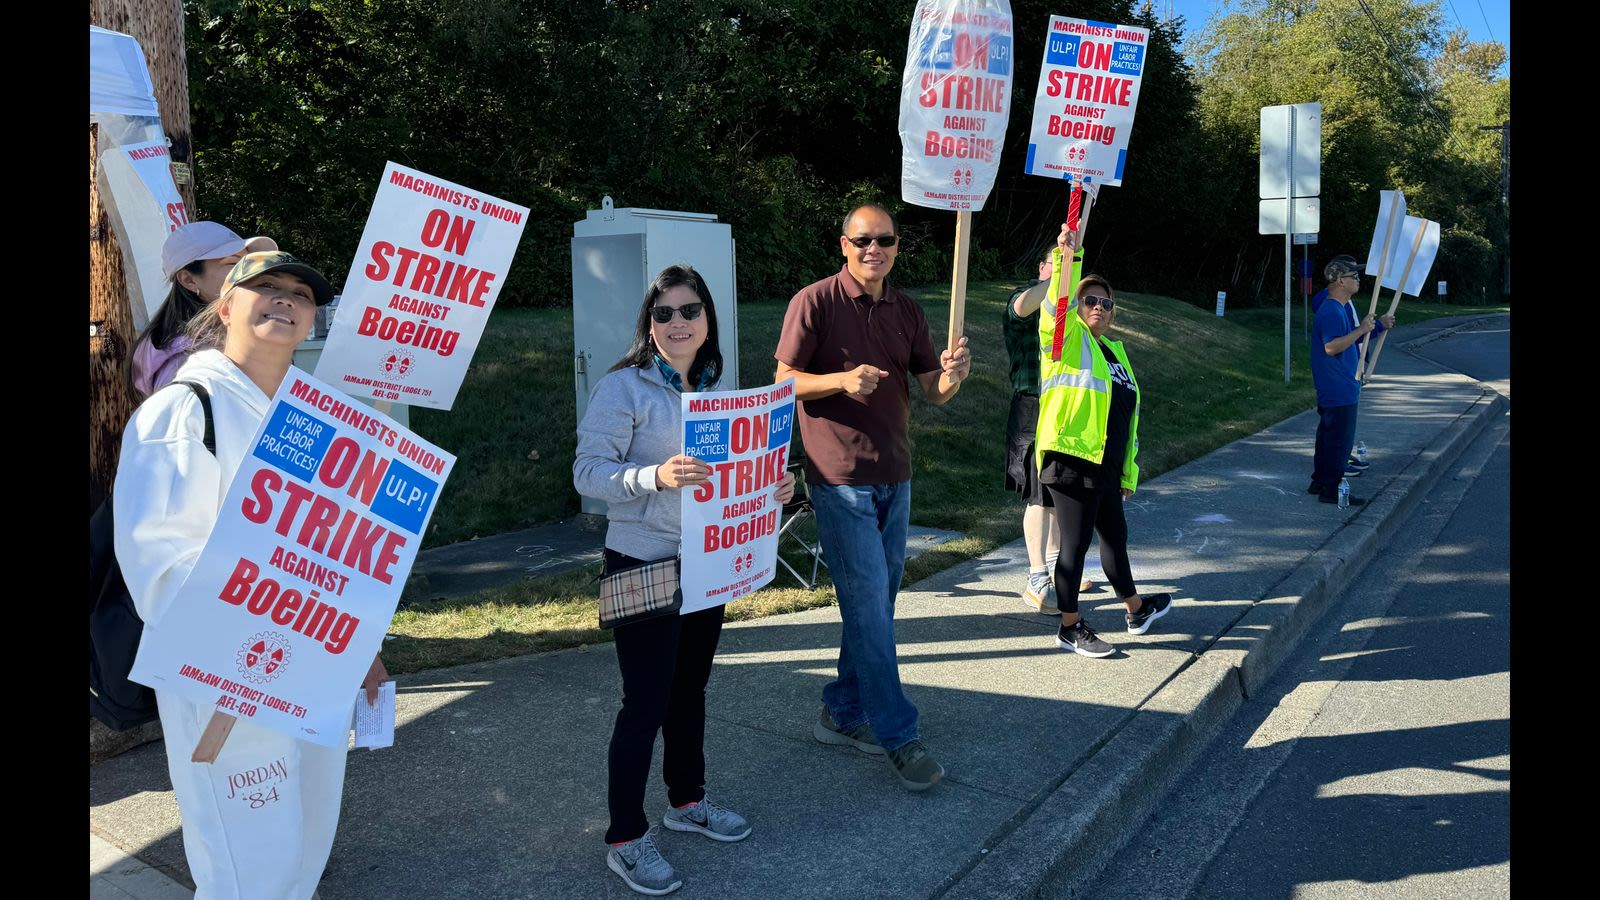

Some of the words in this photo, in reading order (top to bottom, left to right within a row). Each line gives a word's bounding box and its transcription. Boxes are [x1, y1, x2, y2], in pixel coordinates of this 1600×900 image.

[1054, 21, 1113, 38] MACHINISTS
[1115, 30, 1145, 42] UNION
[954, 32, 990, 70] ON
[1052, 41, 1076, 55] ULP!
[1078, 41, 1112, 71] ON
[1119, 53, 1136, 61] LABOR
[1120, 45, 1138, 53] UNFAIR
[1111, 61, 1141, 71] PRACTICES!
[919, 72, 1004, 113] STRIKE
[1046, 70, 1133, 107] STRIKE
[944, 116, 986, 131] AGAINST
[1064, 104, 1106, 119] AGAINST
[1048, 115, 1116, 145] Boeing
[924, 130, 994, 162] Boeing
[390, 170, 480, 211] MACHINISTS
[481, 201, 522, 224] UNION
[950, 201, 970, 209] AFL-CIO
[421, 209, 476, 256] ON
[365, 240, 496, 308] STRIKE
[388, 294, 450, 320] AGAINST
[357, 306, 460, 356] Boeing
[344, 374, 372, 386] IAM&AW
[372, 380, 402, 392] DISTRICT
[402, 386, 422, 396] LODGE
[372, 390, 400, 400] AFL-CIO
[690, 393, 768, 412] MACHINISTS
[770, 384, 792, 402] UNION
[286, 410, 323, 438] UNFAIR
[290, 378, 398, 448] MACHINISTS
[397, 437, 446, 476] UNION
[695, 422, 720, 433] UNFAIR
[731, 413, 769, 454] ON
[772, 413, 790, 433] ULP!
[260, 434, 319, 472] PRACTICES!
[280, 425, 314, 452] LABOR
[686, 444, 727, 456] PRACTICES!
[696, 434, 719, 444] LABOR
[318, 437, 389, 506] ON
[694, 445, 786, 502] STRIKE
[385, 474, 427, 512] ULP!
[722, 494, 767, 520] AGAINST
[241, 468, 407, 585] STRIKE
[704, 509, 777, 553] Boeing
[269, 546, 350, 596] AGAINST
[730, 578, 751, 590] DISTRICT
[218, 557, 360, 654] Boeing
[179, 664, 222, 688] IAM&AW
[220, 676, 262, 703] DISTRICT
[262, 694, 292, 713] LODGE
[291, 704, 307, 719] 751
[218, 695, 257, 717] AFL-CIO
[227, 757, 287, 800] JORDAN
